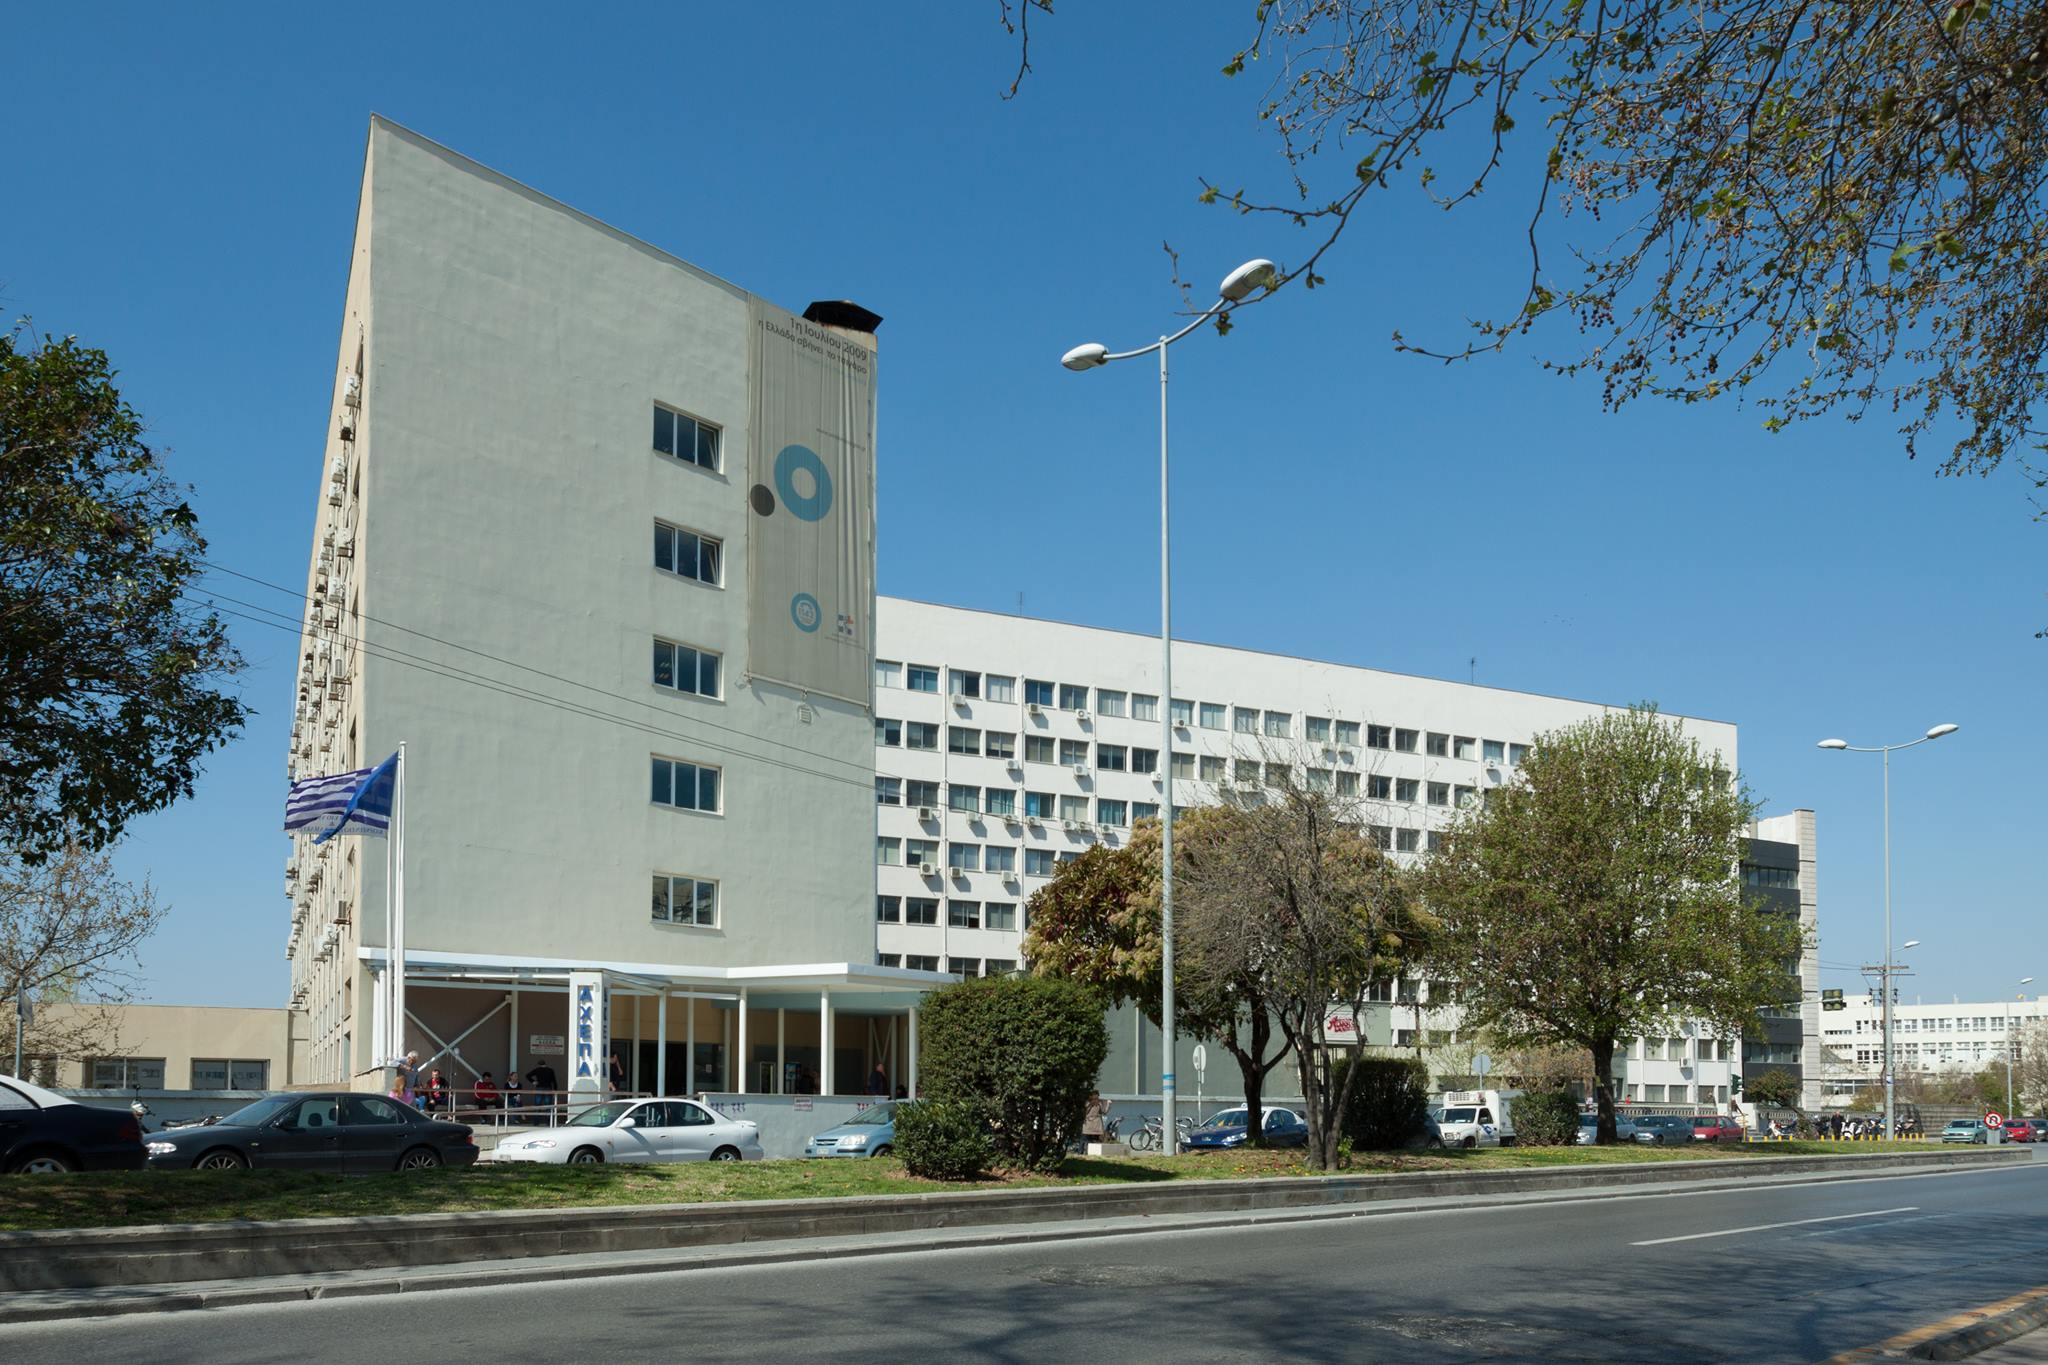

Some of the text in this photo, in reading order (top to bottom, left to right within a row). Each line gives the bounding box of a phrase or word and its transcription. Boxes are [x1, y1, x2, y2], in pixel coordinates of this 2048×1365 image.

[766, 320, 795, 342] Ελλάδα
[790, 318, 867, 361] 1η Ιουλίου 2009
